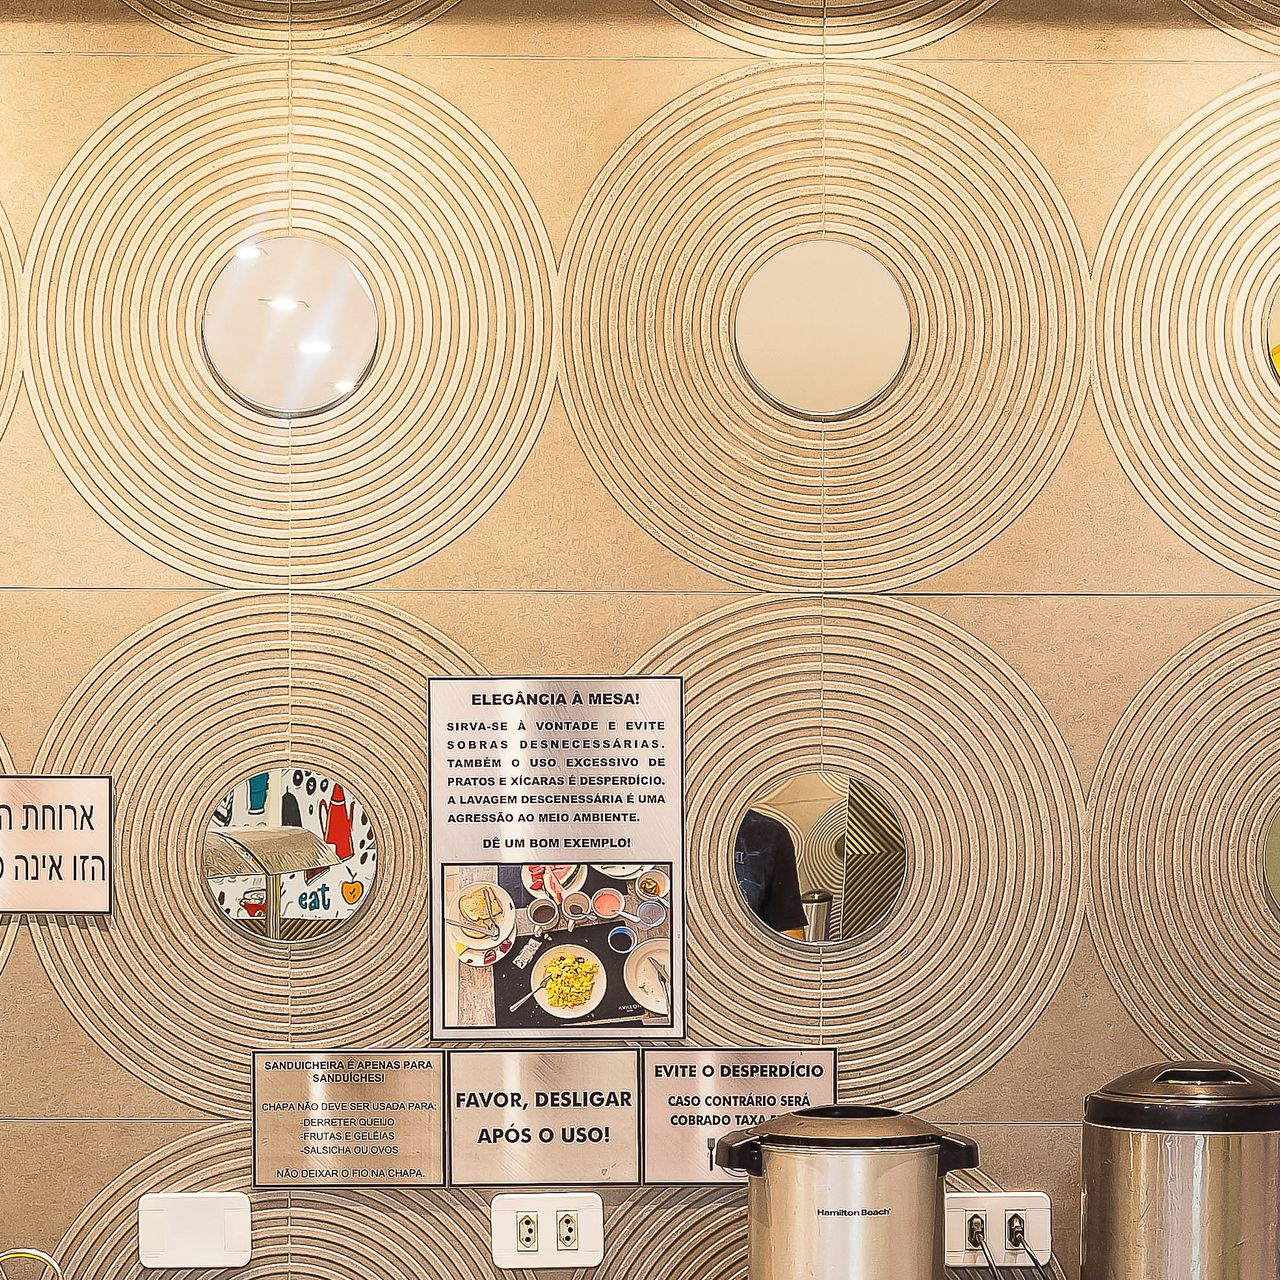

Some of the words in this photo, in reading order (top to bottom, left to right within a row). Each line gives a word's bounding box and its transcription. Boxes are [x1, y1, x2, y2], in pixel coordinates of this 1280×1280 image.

[472, 692, 567, 706] ELEGÂNCIA
[572, 690, 584, 704] À
[588, 692, 640, 706] MESA!
[447, 722, 508, 731] SIRVA-SE
[518, 720, 526, 730] À
[536, 722, 598, 731] VONTADE
[608, 722, 616, 731] E
[626, 722, 665, 731] EVITE
[447, 740, 508, 750] SOBRAS
[520, 738, 666, 750] DESNECESSÁRIAS.
[447, 757, 502, 768] TAMBÉM
[512, 759, 520, 768] O
[530, 759, 556, 768] USO
[566, 758, 639, 767] EXCESSIVO
[648, 758, 666, 767] DE
[448, 777, 496, 786] PRATOS
[500, 777, 506, 786] E
[510, 775, 564, 786] XÍCARAS
[568, 775, 576, 786] É
[580, 775, 666, 786] DESPERDÍCIO.
[448, 795, 456, 804] A
[460, 795, 518, 804] LAVAGEM
[522, 793, 622, 804] DESCENESSÁRIA
[626, 793, 634, 804] É
[638, 795, 666, 804] UMA
[22, 804, 95, 830] ארוחת
[448, 811, 514, 822] AGRESSÃO
[518, 813, 534, 822] AO
[538, 813, 569, 822] MEIO
[573, 813, 640, 822] AMBIENTE.
[483, 836, 500, 848] DÊ
[505, 838, 525, 848] UM
[530, 838, 560, 848] BOM
[564, 838, 630, 848] EXEMPLO!
[15, 855, 64, 881] אינה
[73, 855, 106, 881] הזו
[298, 884, 331, 911] eat
[264, 1061, 345, 1071] SANDUICHEIRA
[348, 1058, 355, 1069] É
[357, 1061, 400, 1070] APENAS
[404, 1061, 432, 1070] PARA
[655, 1065, 696, 1078] EVITE
[702, 1065, 714, 1078] O
[720, 1061, 824, 1078] DESPERDÍCIO
[456, 1092, 529, 1110] FAVOR,
[535, 1091, 632, 1107] DESLIGAR
[668, 1096, 700, 1106] CASO
[705, 1093, 776, 1106] CONTRÁRIO
[780, 1092, 810, 1106] SERÁ
[262, 1102, 295, 1111] CHAPA
[298, 1100, 318, 1111] NÃO
[321, 1102, 348, 1111] DEVE
[350, 1102, 370, 1111] SER
[372, 1102, 406, 1111] USADA
[408, 1102, 436, 1111] PARA:
[300, 1118, 356, 1127] -DERRETER
[359, 1118, 395, 1127] QUEIJO
[670, 1114, 731, 1126] COBRADO
[735, 1114, 765, 1125] TAXA
[300, 1132, 342, 1140] -FRUTAS
[345, 1132, 352, 1140] E
[354, 1131, 395, 1140] GELÉIAS
[477, 1123, 532, 1144] APÓS
[538, 1127, 554, 1143] O
[561, 1127, 610, 1143] USO!
[300, 1146, 352, 1154] -SALSICHA
[354, 1146, 368, 1154] OU
[371, 1146, 398, 1154] OVOS
[276, 1168, 298, 1178] NÃO
[301, 1169, 338, 1178] DEIXAR
[341, 1169, 350, 1178] O
[352, 1169, 368, 1178] FIO
[371, 1169, 386, 1178] NA
[388, 1169, 426, 1178] CHAPA.
[817, 1208, 860, 1216] Hamilton
